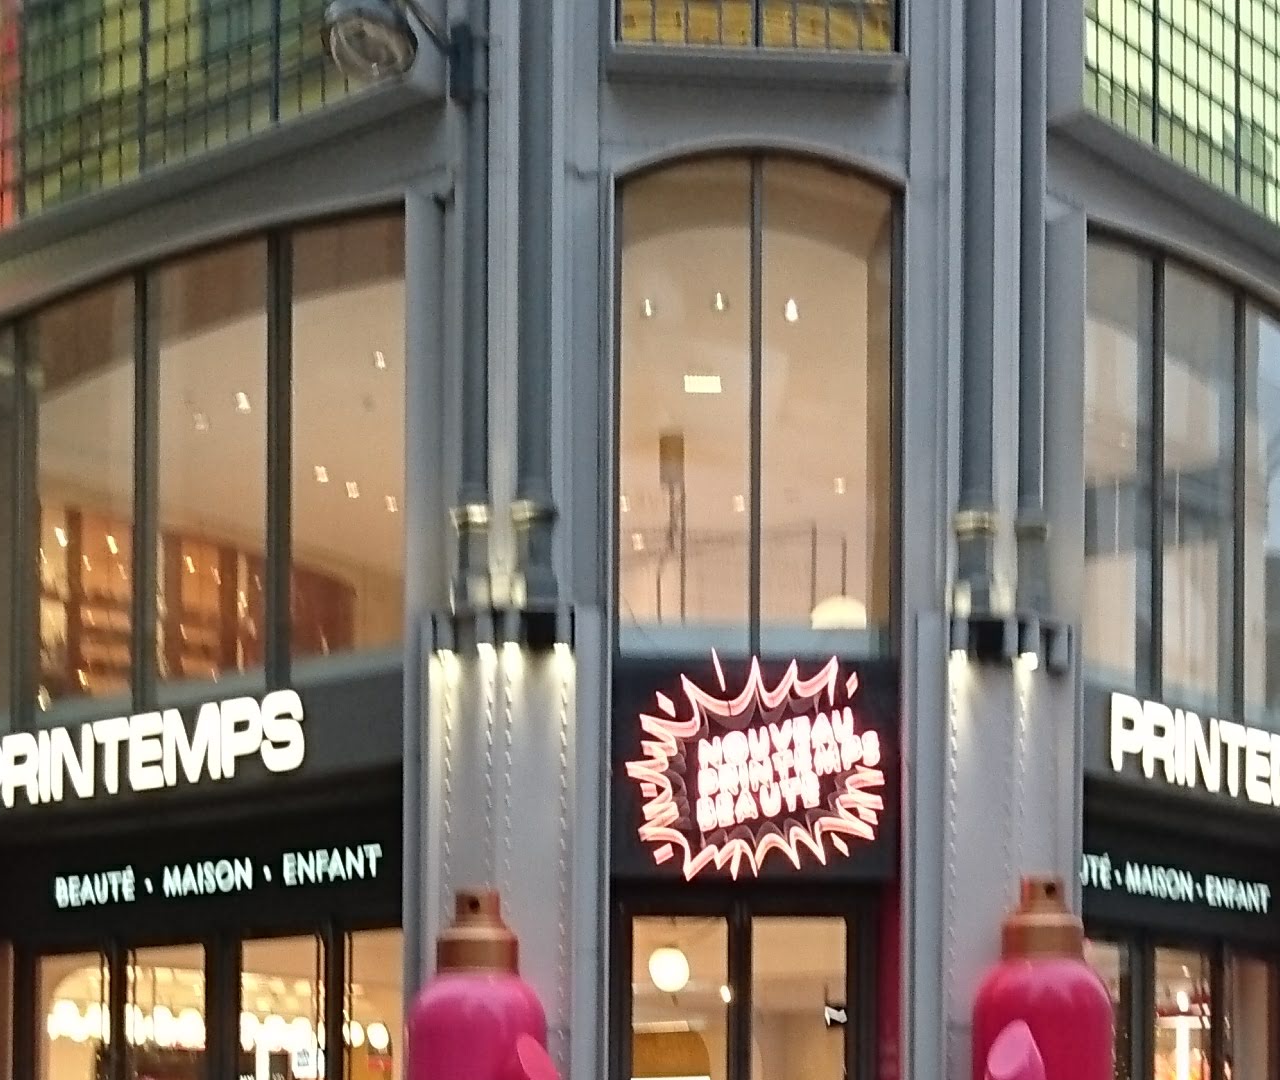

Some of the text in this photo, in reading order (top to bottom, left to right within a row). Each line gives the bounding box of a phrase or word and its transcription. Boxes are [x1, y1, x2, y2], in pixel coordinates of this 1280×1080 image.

[55, 843, 383, 908] BEAUTÉ MAISON ENFANT
[1124, 861, 1194, 903] MAISON
[1205, 873, 1271, 914] ENFANT
